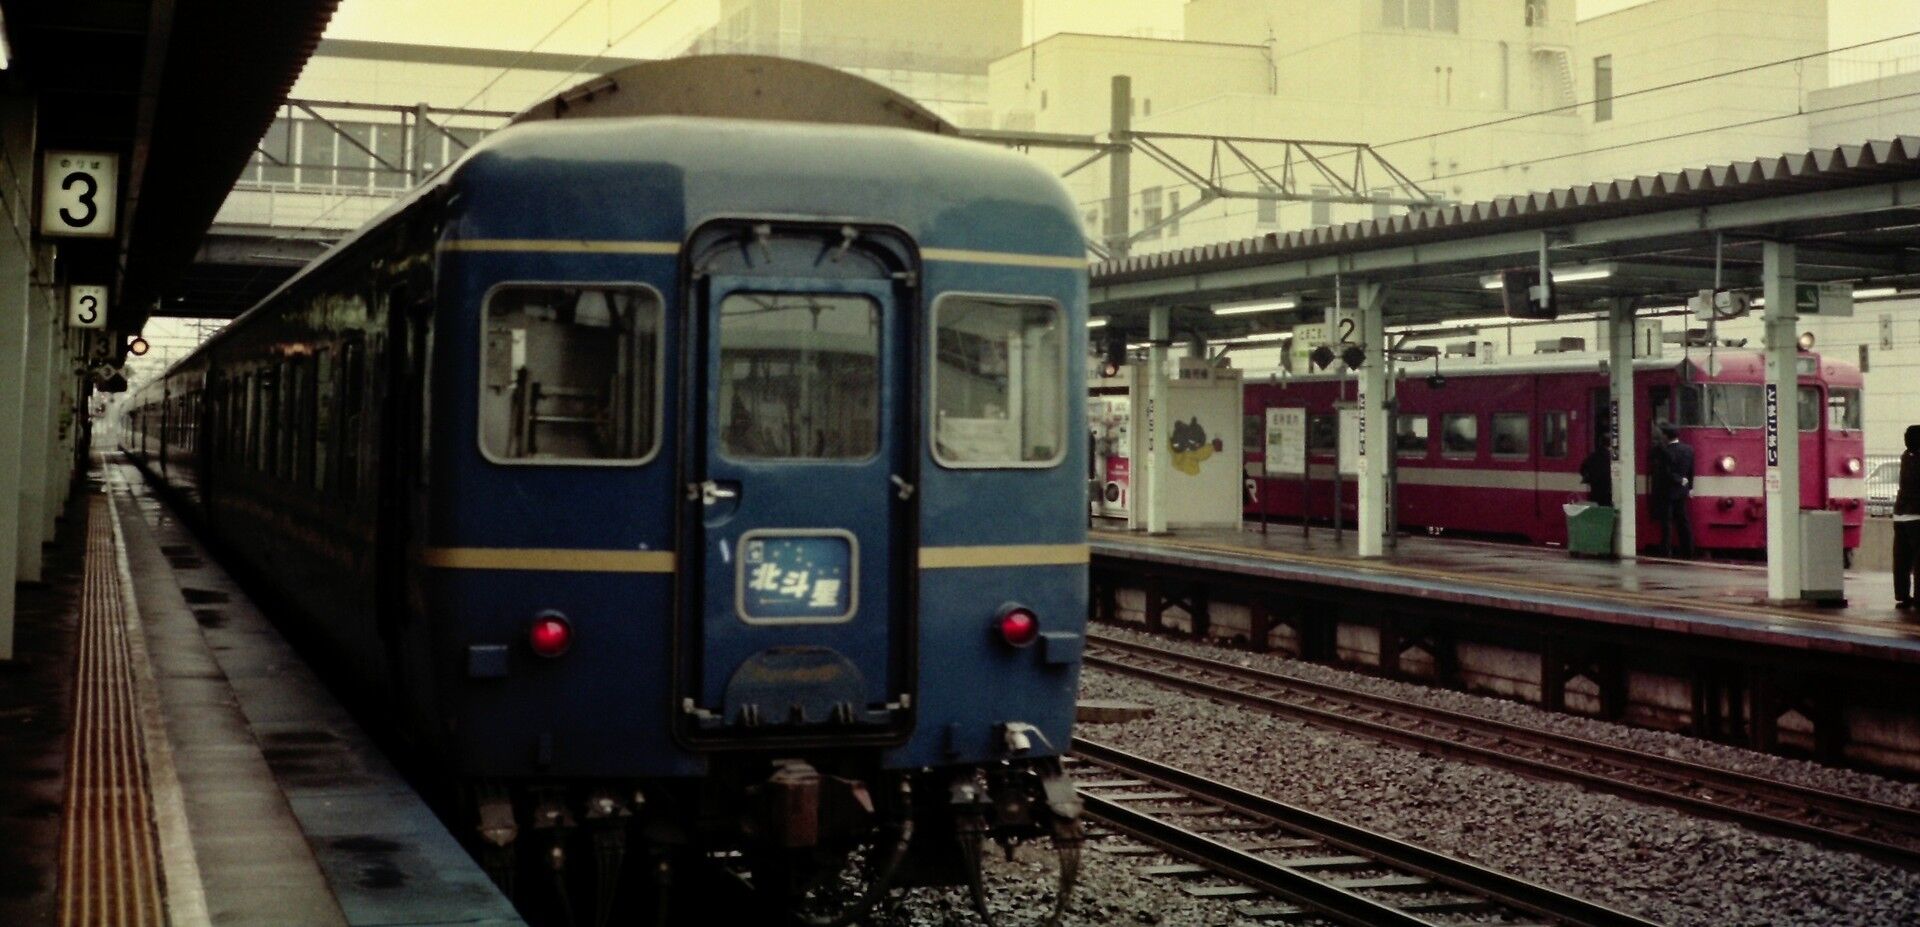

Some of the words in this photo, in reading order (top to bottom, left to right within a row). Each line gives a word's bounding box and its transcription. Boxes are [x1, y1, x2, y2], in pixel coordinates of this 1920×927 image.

[60, 158, 101, 170] のりば
[59, 171, 98, 228] 3
[78, 295, 98, 324] 3
[1339, 318, 1356, 346] 2
[96, 336, 109, 357] 3
[1768, 389, 1777, 463] とまこまい
